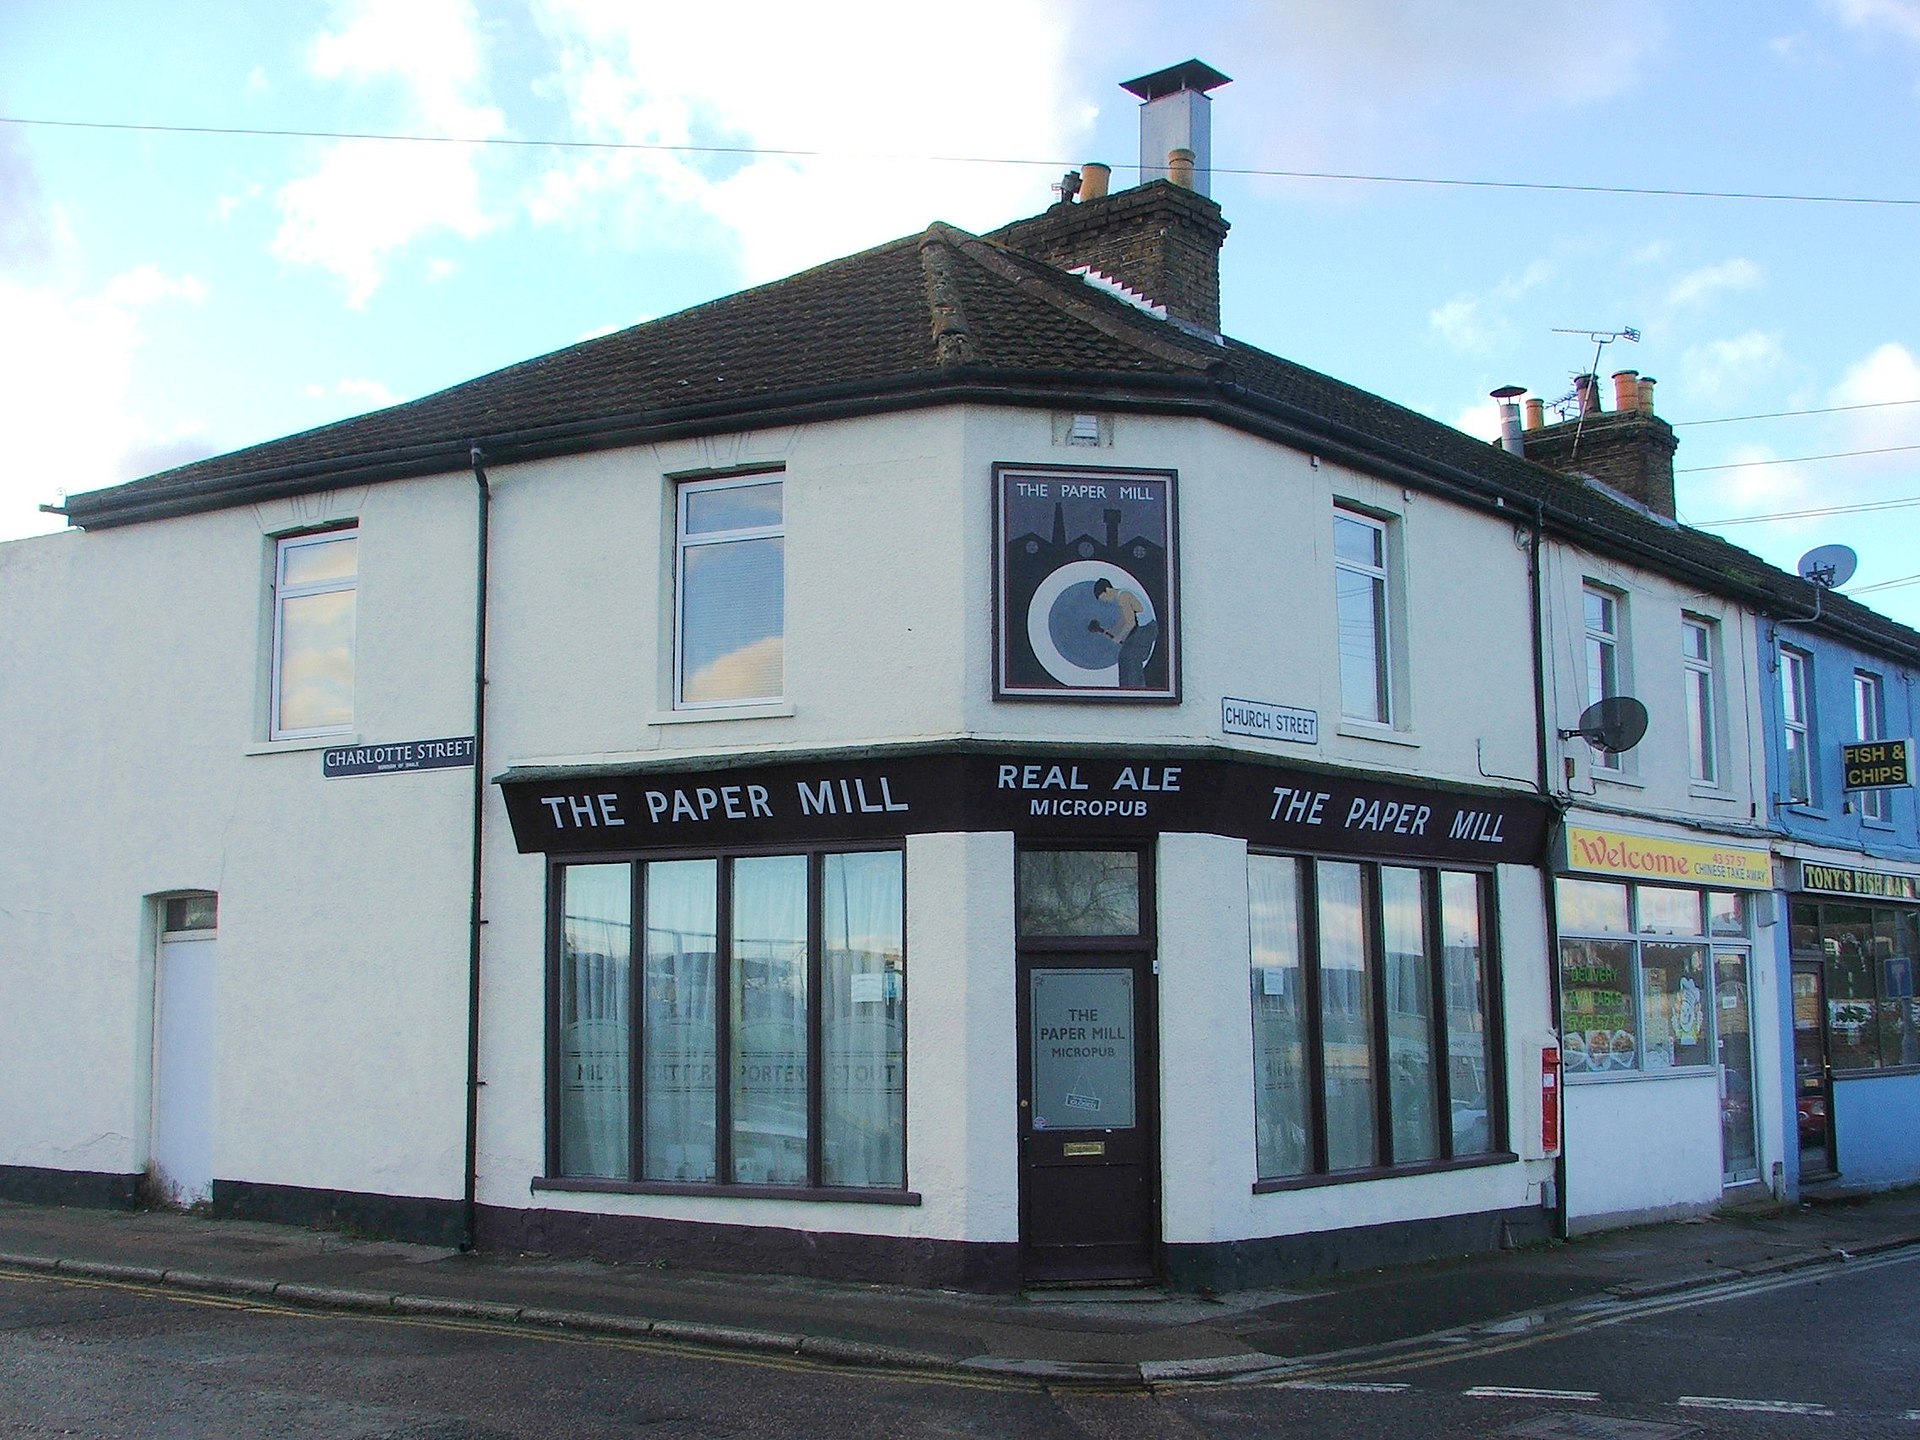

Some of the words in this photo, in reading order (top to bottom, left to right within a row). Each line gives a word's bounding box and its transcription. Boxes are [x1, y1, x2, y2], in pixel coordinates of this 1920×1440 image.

[1017, 483, 1048, 497] THE
[1061, 484, 1107, 499] PAPER
[1120, 486, 1154, 500] MILL
[1225, 707, 1271, 729] CHURCH
[1276, 715, 1315, 736] STREET
[326, 745, 411, 767] CHARLOTTE
[417, 740, 473, 759] STREET
[1844, 746, 1885, 764] FISH
[1892, 744, 1905, 760] &
[998, 765, 1089, 790] REAL
[1112, 767, 1182, 791] ALE
[1848, 765, 1905, 785] CHIPS
[540, 793, 625, 829] THE
[645, 784, 774, 824] PAPER
[797, 777, 909, 816] MILL
[1029, 800, 1148, 817] MICROPUB
[1270, 787, 1331, 825] THE
[1344, 798, 1431, 836] PAPER
[1449, 810, 1504, 843] MILL
[1578, 836, 1690, 875] Welcome
[1694, 862, 1726, 878] CHINESE
[1727, 866, 1745, 880] TAKE
[1746, 869, 1766, 882] AWAY
[1805, 865, 1852, 892] TONY'S
[1854, 871, 1883, 895] FISH
[1886, 875, 1912, 898] BAR
[1571, 967, 1618, 983] DELIVERY
[1068, 1008, 1098, 1022] THE
[1041, 1027, 1086, 1041] PAPER
[1092, 1027, 1125, 1040] MILL
[1051, 1047, 1116, 1058] MICROPUB
